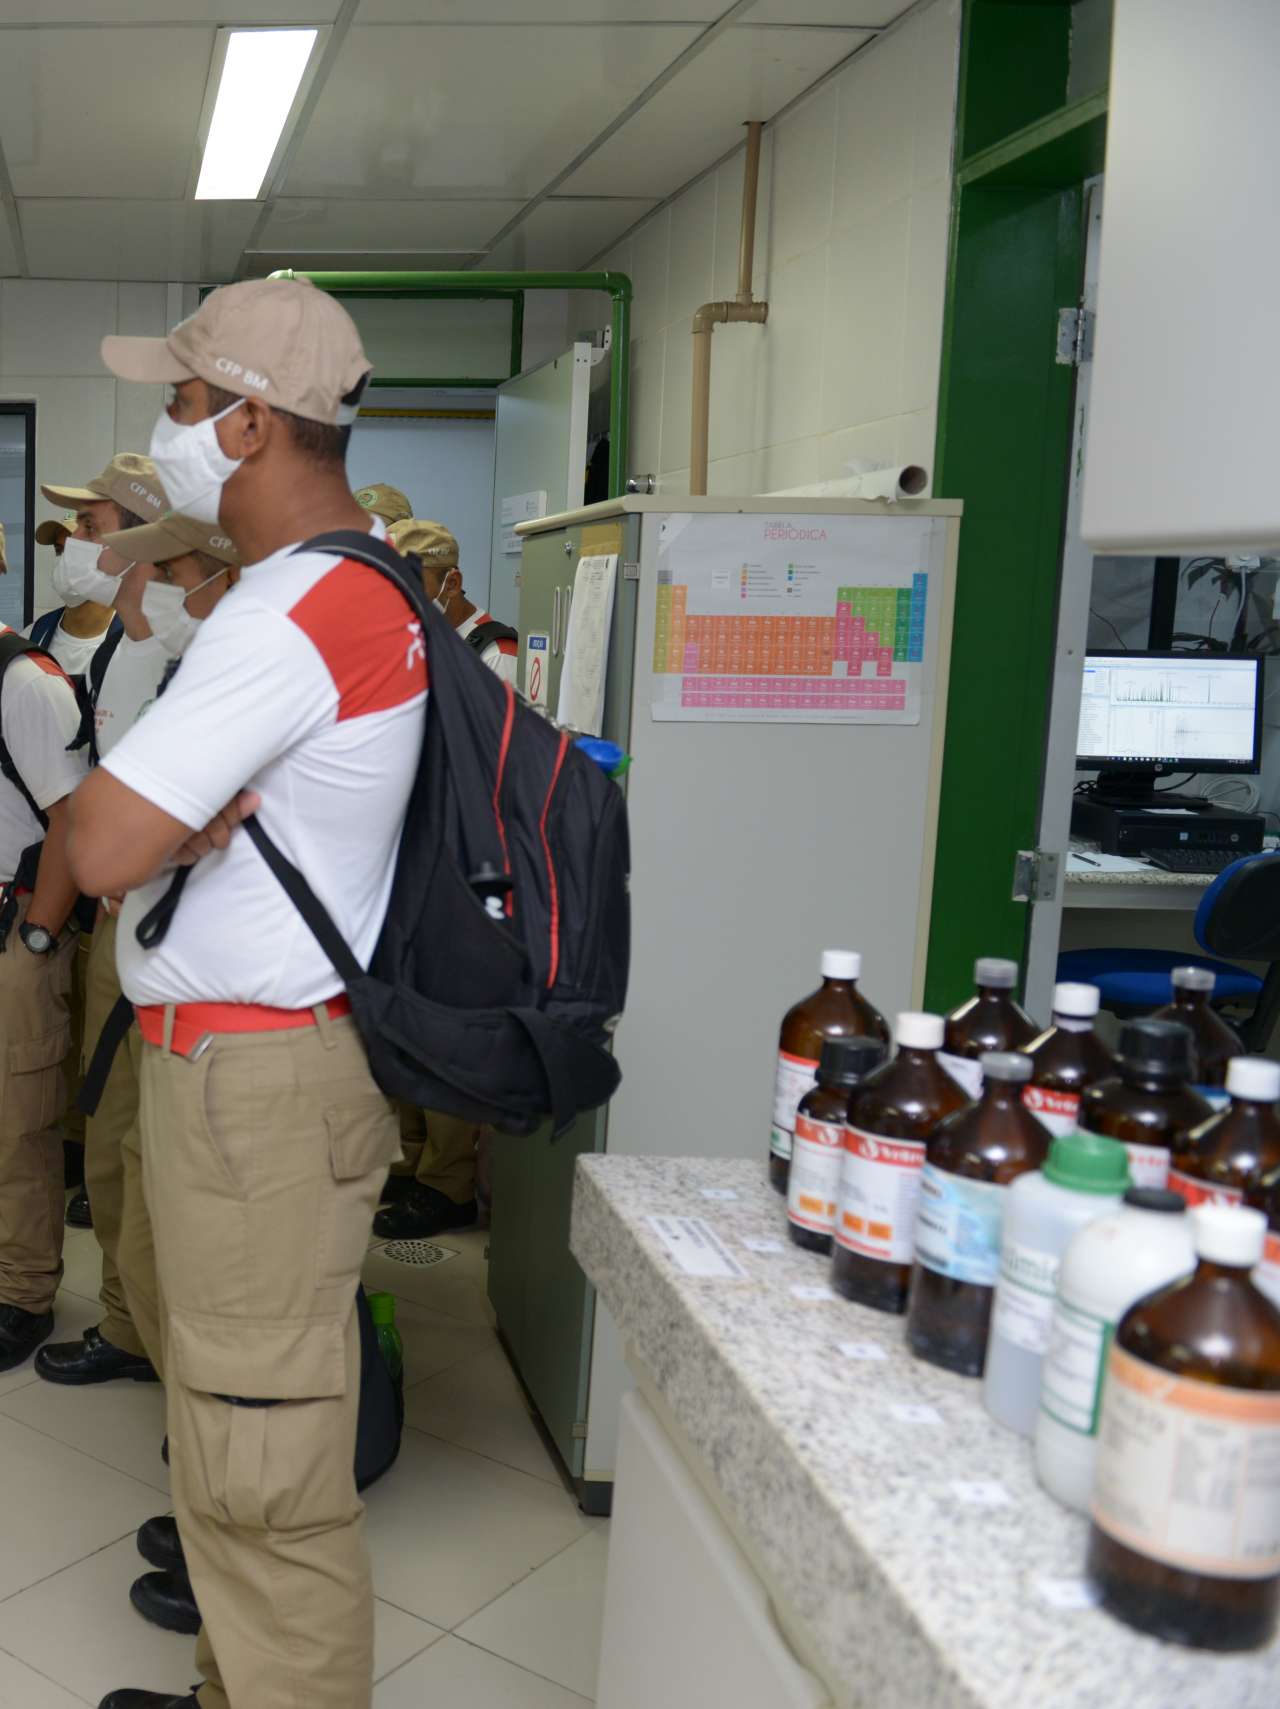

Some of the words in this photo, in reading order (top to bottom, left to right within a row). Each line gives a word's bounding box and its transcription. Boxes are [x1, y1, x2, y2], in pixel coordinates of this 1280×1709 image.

[215, 358, 243, 377] CFP
[243, 369, 269, 392] BM
[130, 482, 148, 497] CFP
[146, 493, 161, 509] BM
[209, 535, 233, 551] CFP
